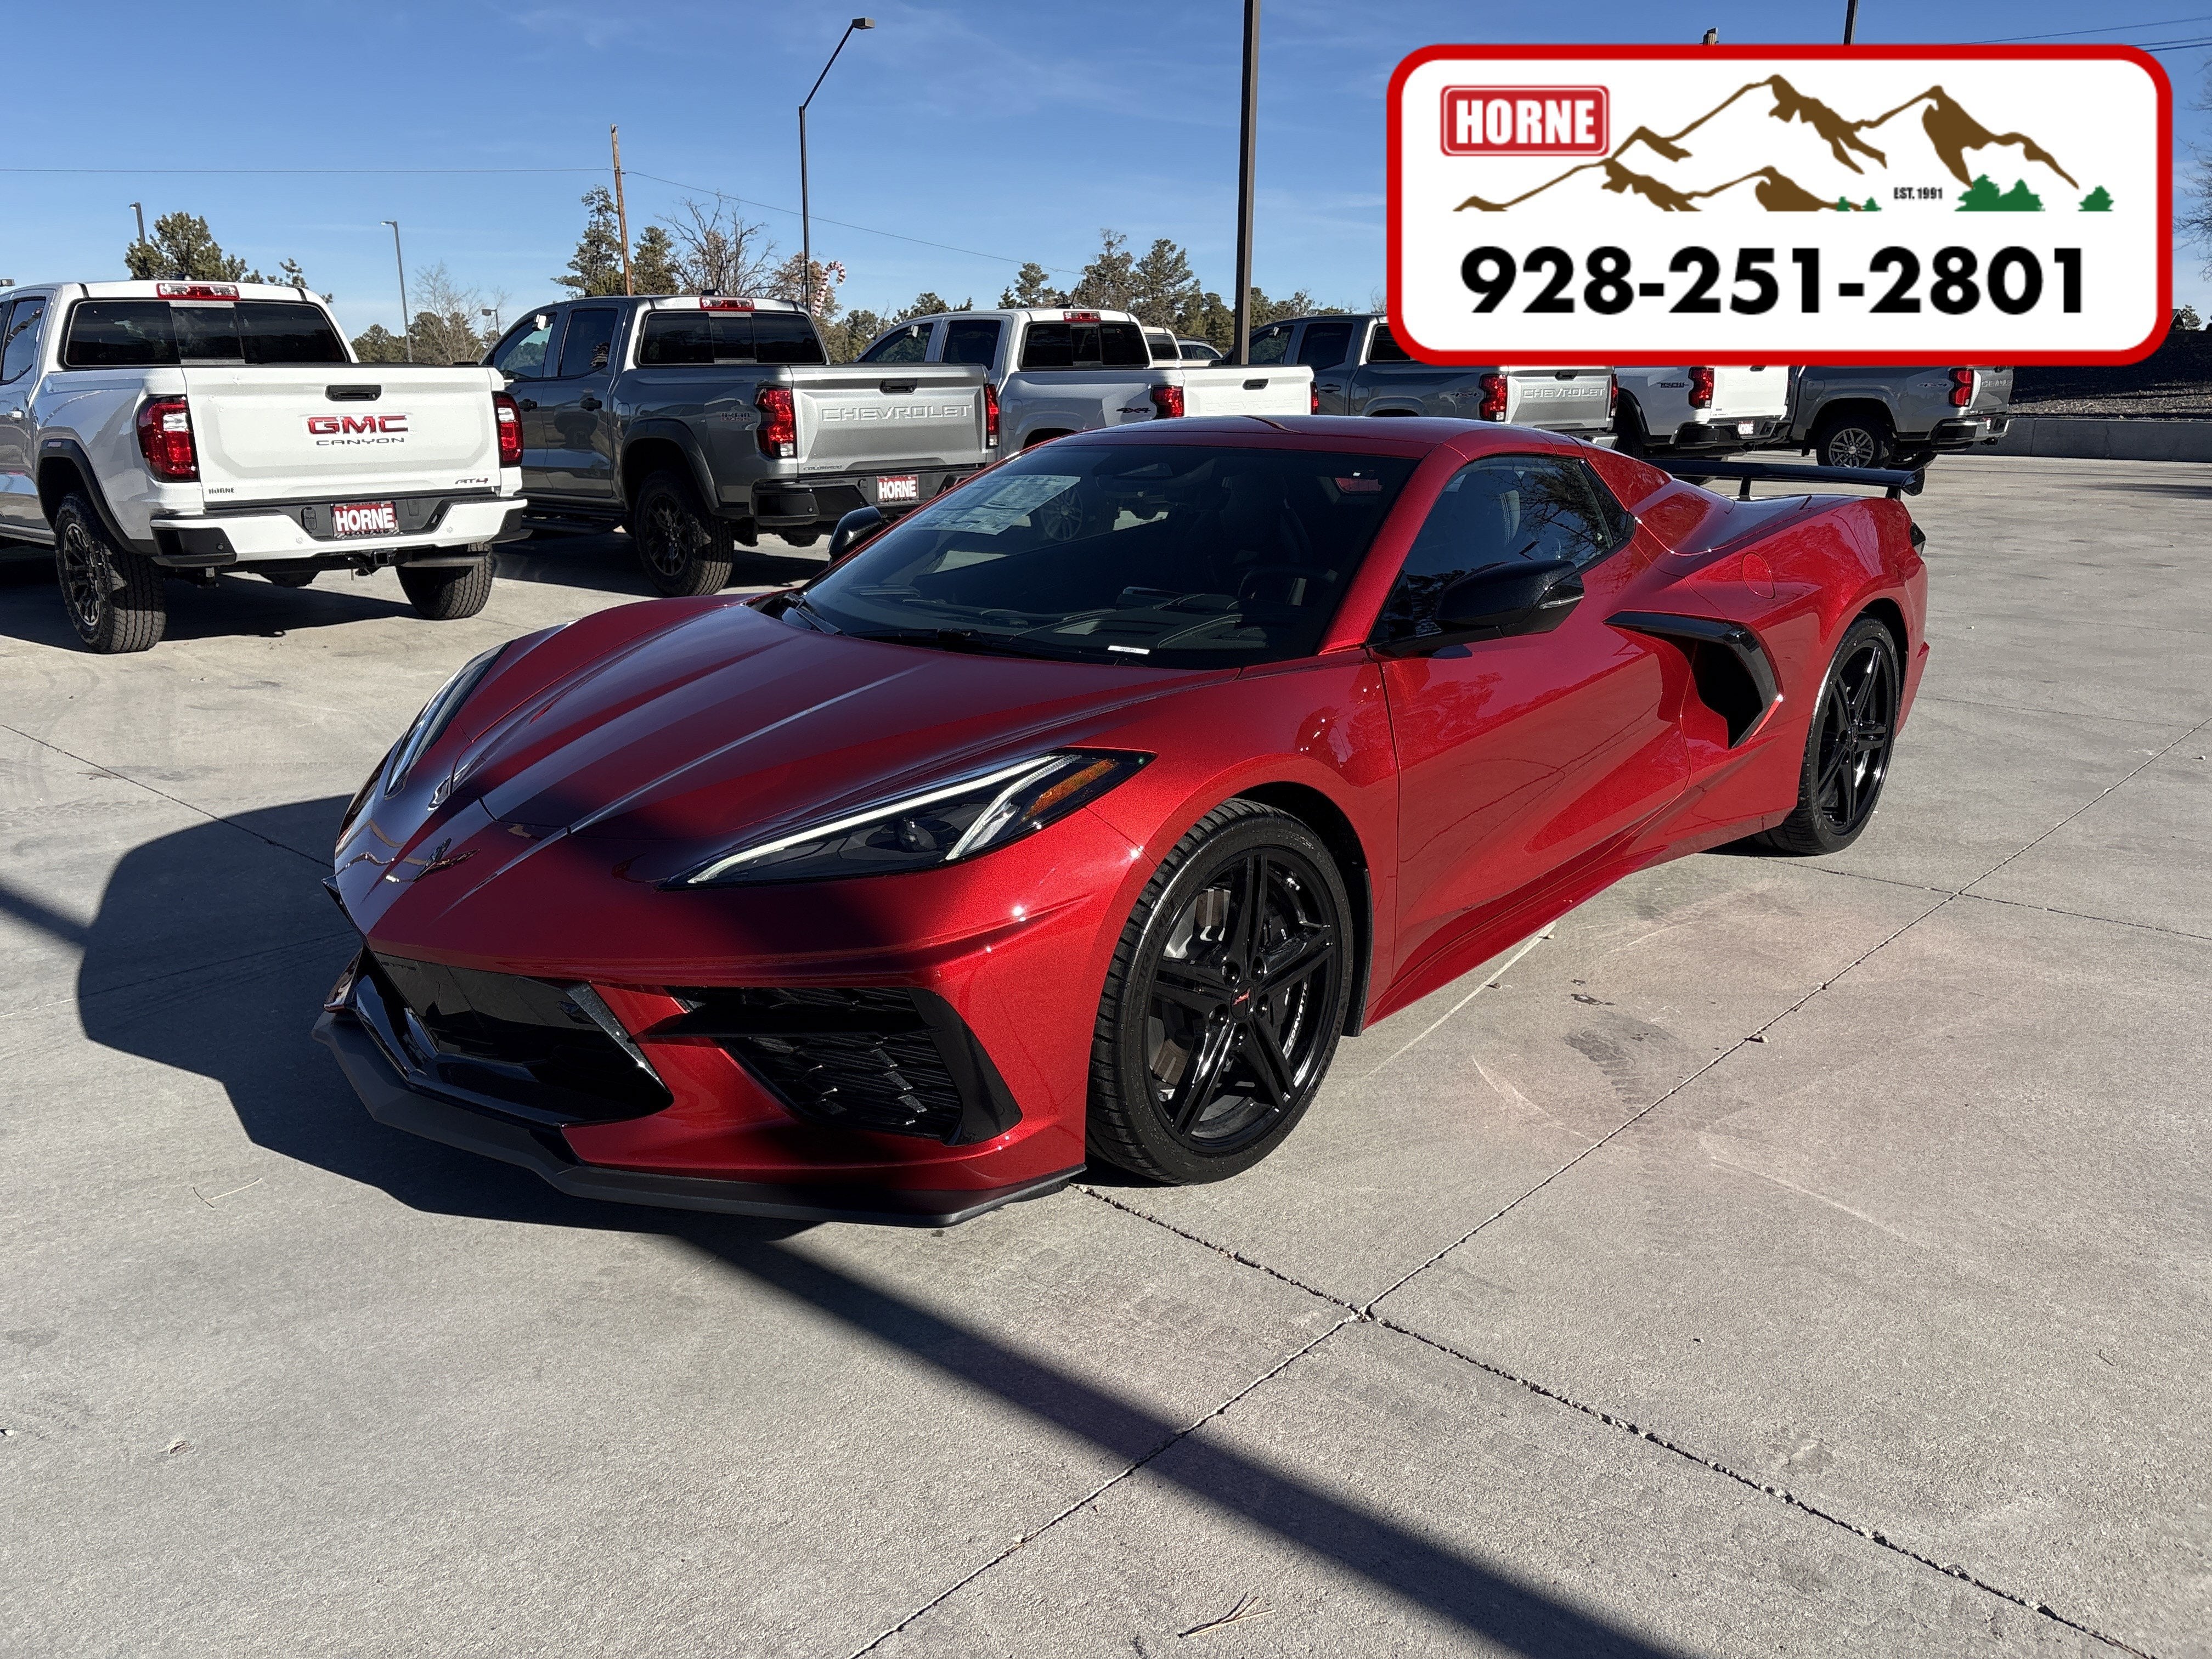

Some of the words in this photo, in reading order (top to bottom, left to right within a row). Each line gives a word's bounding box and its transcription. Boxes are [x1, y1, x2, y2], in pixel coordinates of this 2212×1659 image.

[1523, 387, 1605, 398] CHEVROLET
[822, 404, 970, 421] CHEVROLET
[307, 415, 409, 435] GMC
[316, 437, 405, 445] CANYON
[879, 480, 917, 499] HORNE
[335, 507, 394, 532] HORNE
[1288, 981, 1308, 1046] CORVETTE
